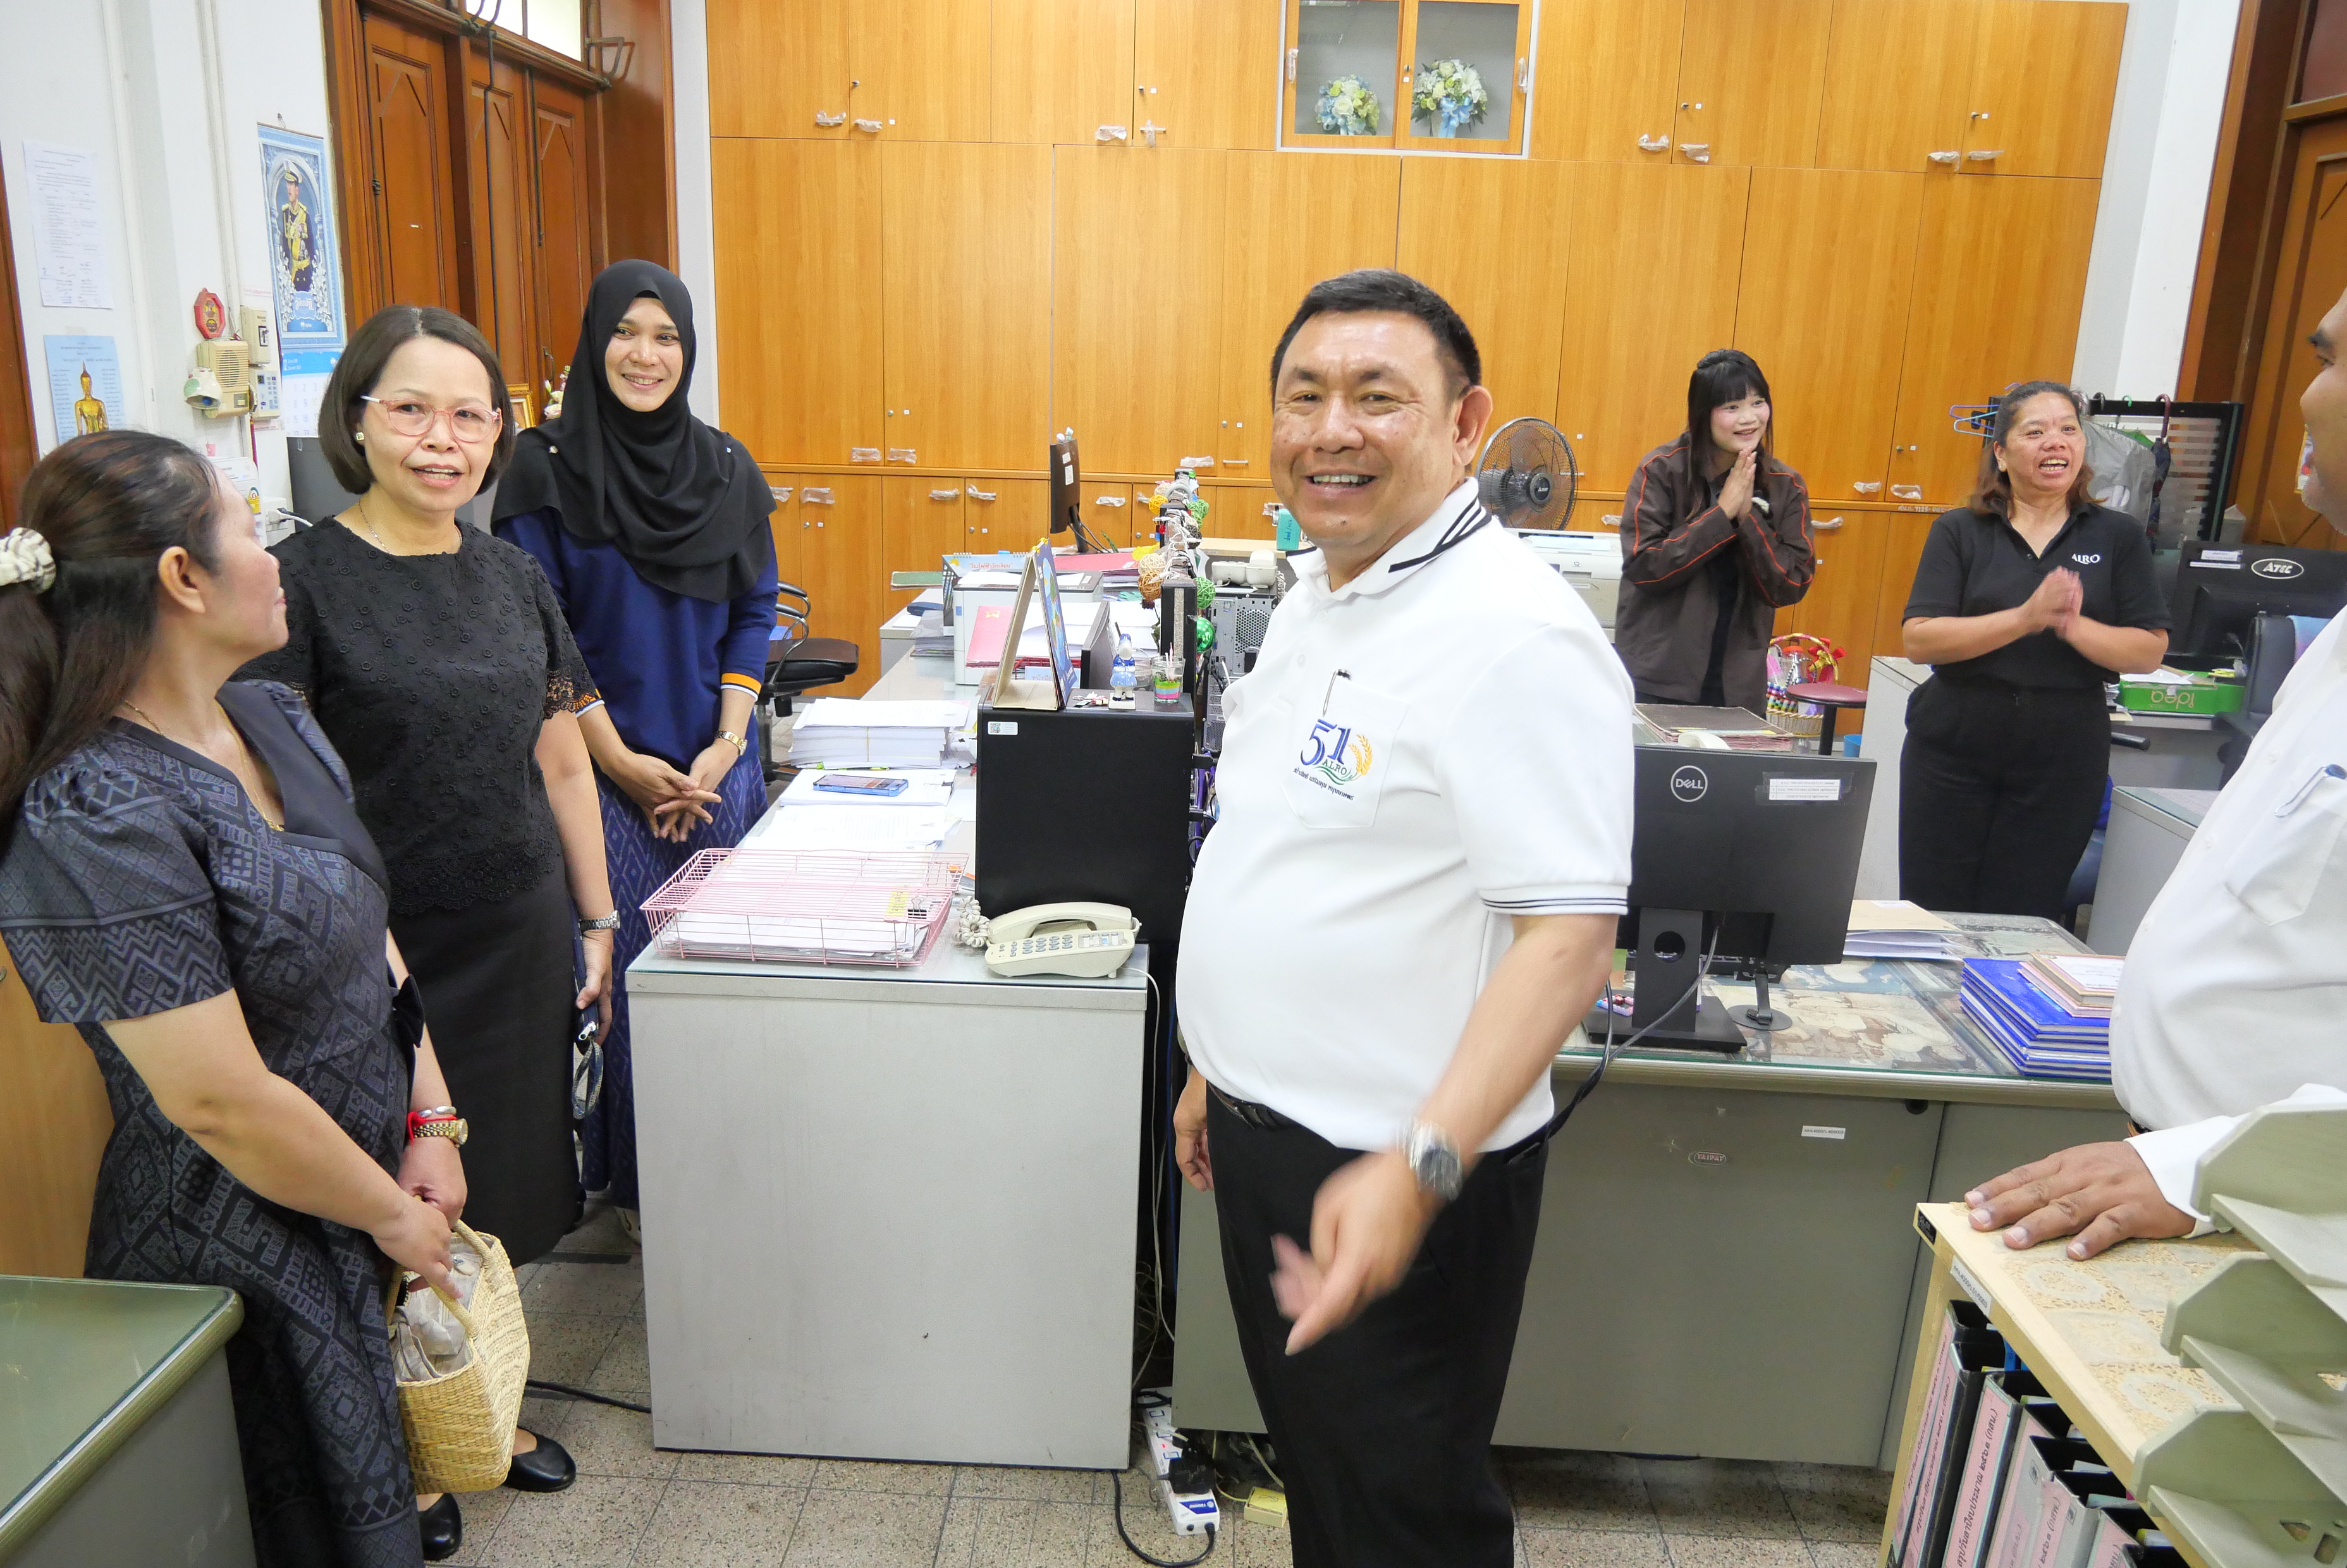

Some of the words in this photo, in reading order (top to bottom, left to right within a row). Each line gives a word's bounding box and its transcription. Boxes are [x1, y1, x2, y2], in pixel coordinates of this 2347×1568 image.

[2071, 553, 2100, 565] ALRO
[2262, 561, 2293, 575] ATEC
[1300, 718, 1352, 766] 51
[1321, 759, 1347, 776] ALRO
[1676, 778, 1703, 790] DELL
